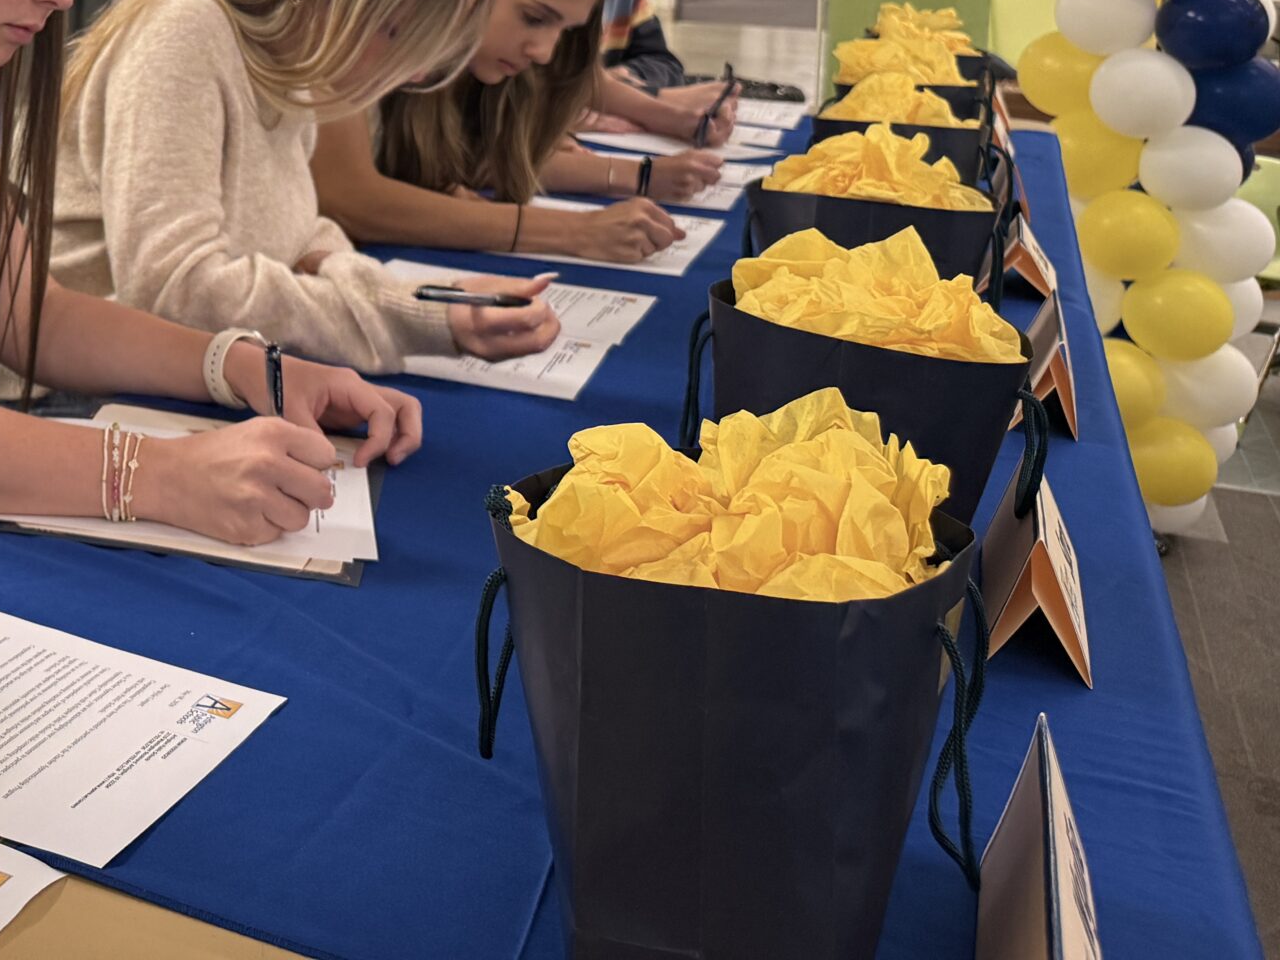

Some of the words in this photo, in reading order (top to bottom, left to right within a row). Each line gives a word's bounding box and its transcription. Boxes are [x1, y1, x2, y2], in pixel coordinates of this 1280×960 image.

[176, 708, 198, 724] Schools
[188, 711, 207, 725] Public
[191, 714, 215, 733] Arlington
